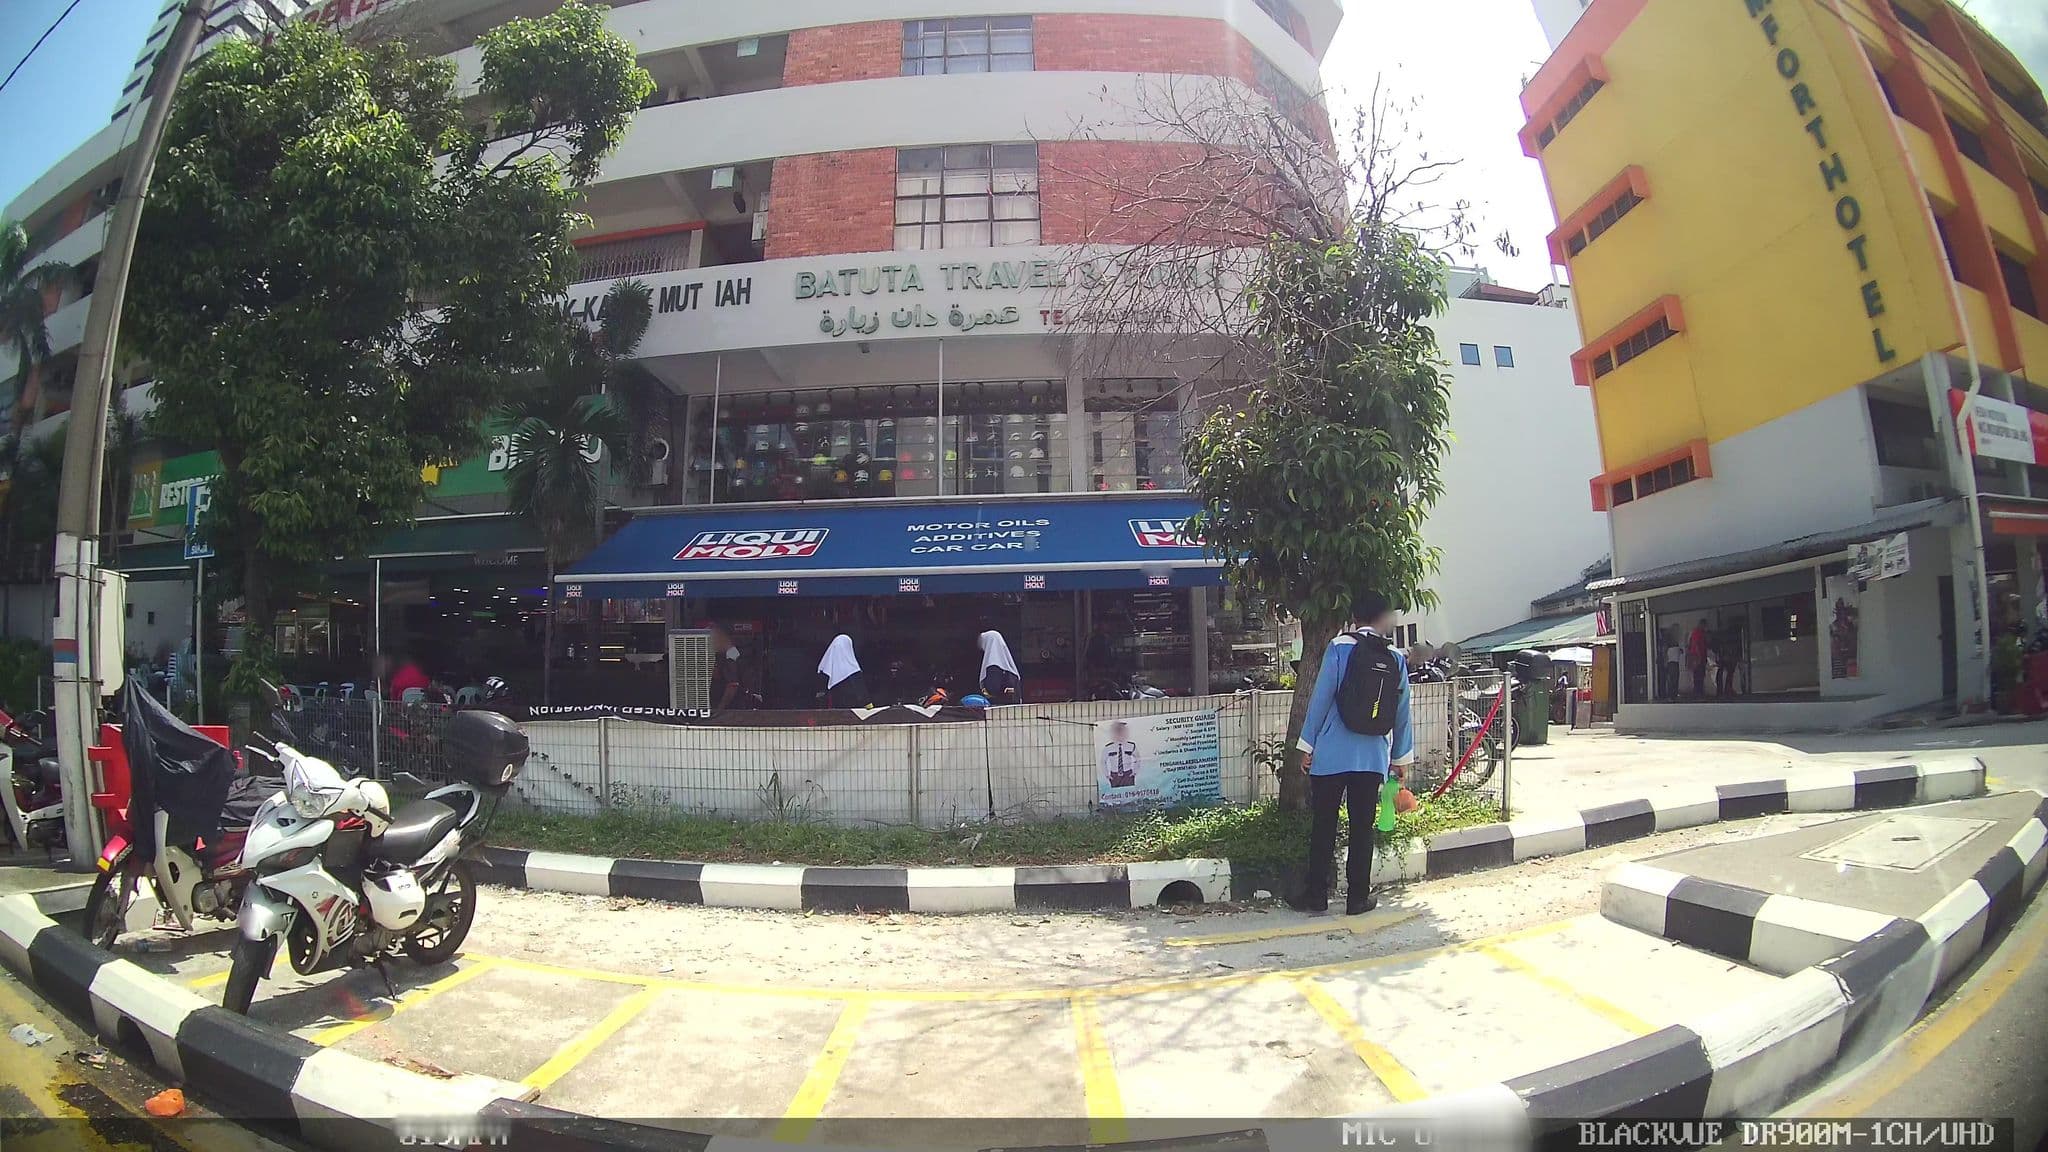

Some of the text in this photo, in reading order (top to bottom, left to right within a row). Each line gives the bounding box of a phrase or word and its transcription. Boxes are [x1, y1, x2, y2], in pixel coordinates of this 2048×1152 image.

[795, 264, 924, 299] BATUTA
[940, 260, 1066, 291] TRAVEL
[819, 306, 880, 337] زيارة
[891, 304, 938, 328] دان
[907, 519, 1051, 532] MOTOR OILS
[696, 531, 821, 545] LIQUI
[914, 530, 1041, 543] ADDITIVES
[684, 543, 816, 558] MOLY
[910, 545, 963, 554] CAR
[622, 706, 711, 718] ADVANCED
